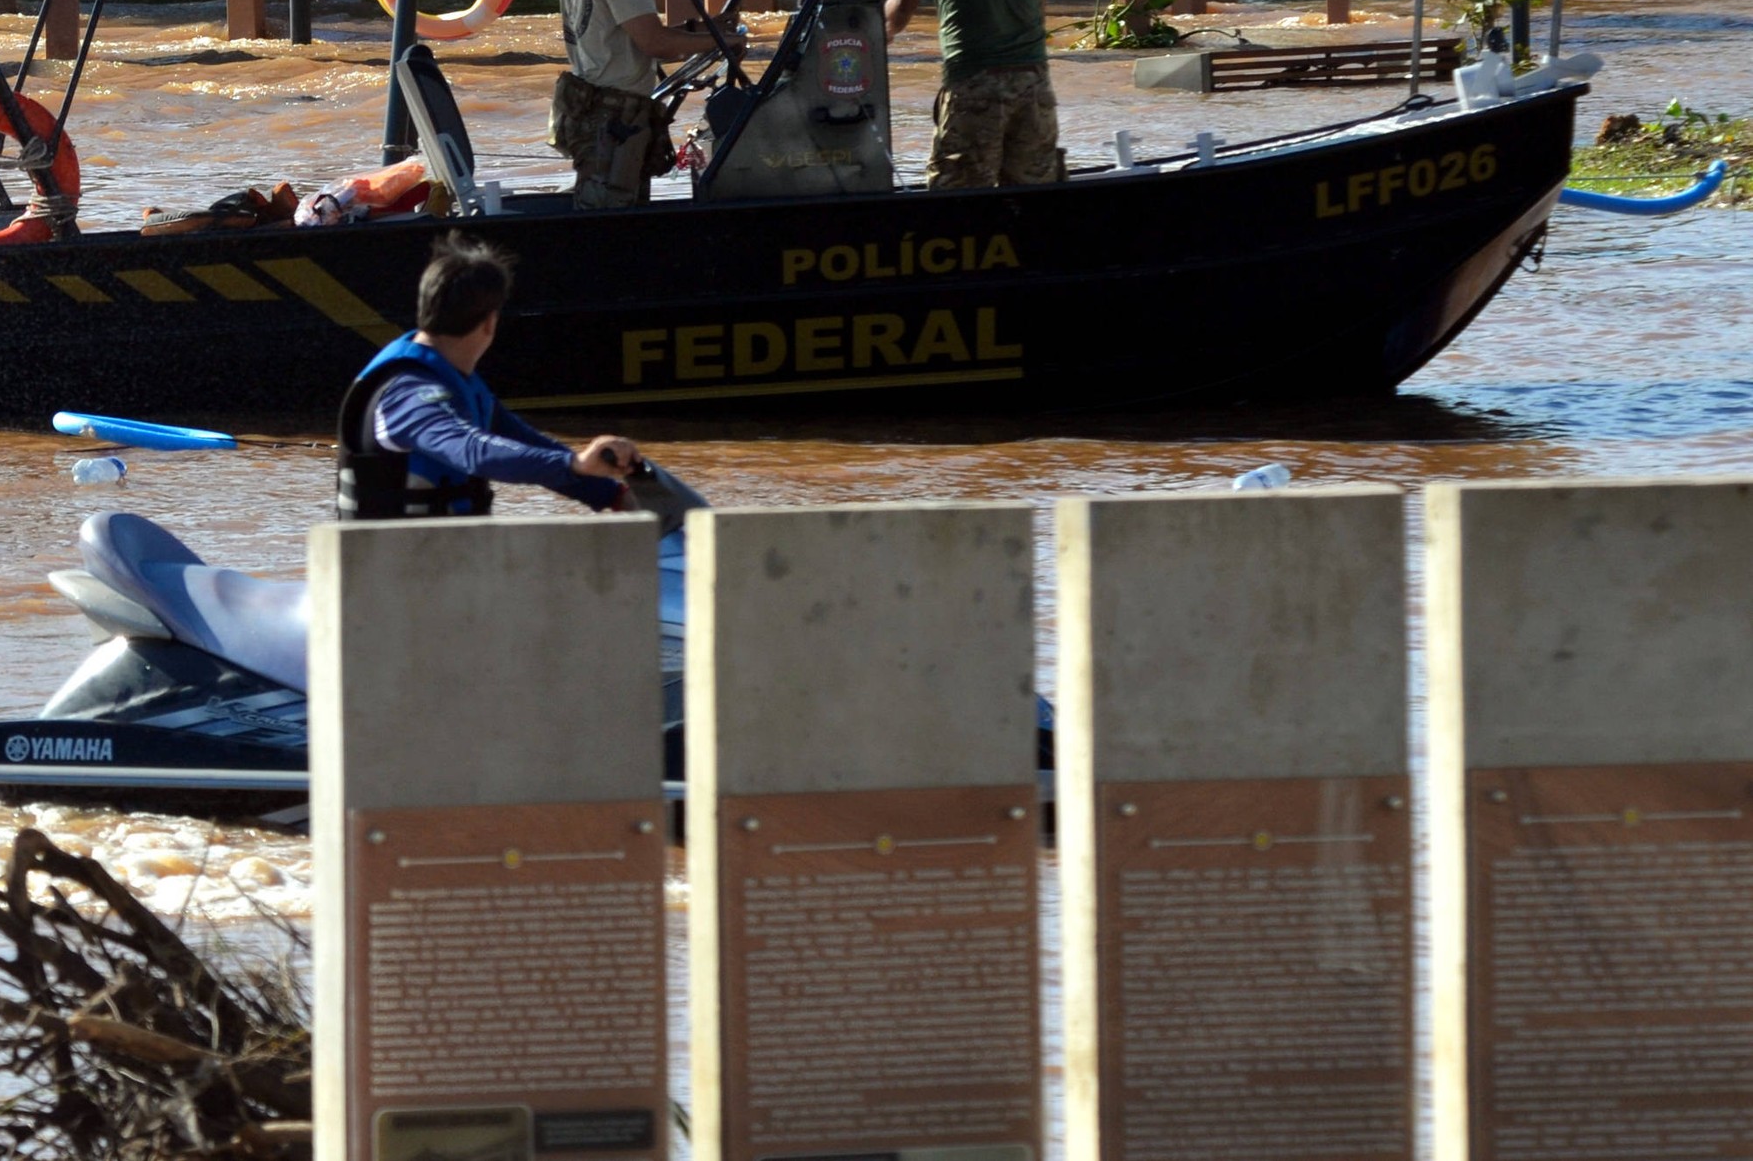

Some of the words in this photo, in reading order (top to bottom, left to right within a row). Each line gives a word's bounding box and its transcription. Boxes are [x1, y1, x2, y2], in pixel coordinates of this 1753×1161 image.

[828, 84, 865, 95] FEDERAL
[1315, 143, 1498, 219] LFF026
[782, 232, 1021, 285] POLÍCIA
[621, 307, 1023, 385] FEDERAL
[32, 737, 114, 761] YAMAHA
